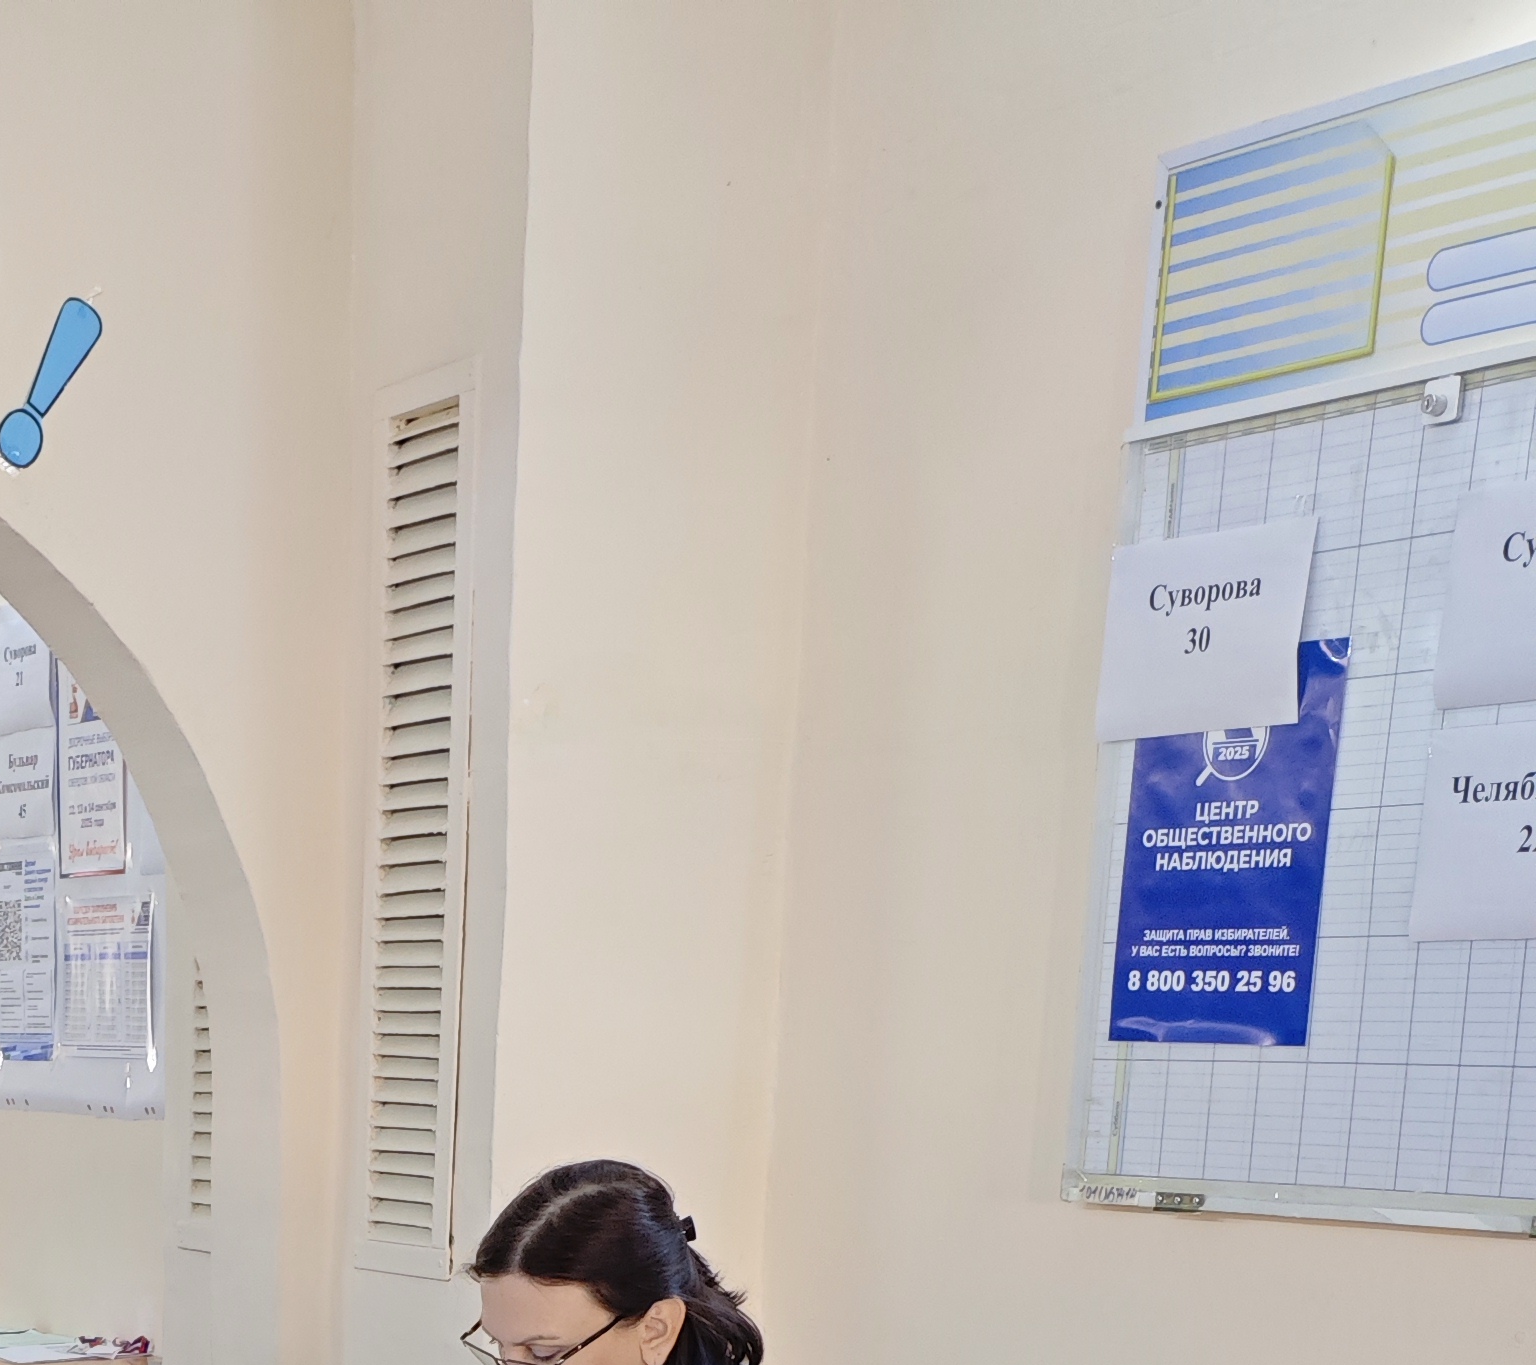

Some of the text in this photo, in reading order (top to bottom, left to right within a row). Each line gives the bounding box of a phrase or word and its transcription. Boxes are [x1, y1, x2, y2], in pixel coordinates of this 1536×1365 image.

[1149, 577, 1262, 617] Суворова
[1184, 625, 1211, 655] 30
[4, 643, 37, 665] Суворова
[8, 753, 39, 772] Бульвар
[1217, 745, 1250, 761] 2025
[1451, 771, 1536, 804] Челяб
[1195, 800, 1259, 824] ЦЕНТР
[1142, 822, 1312, 849] ОБЩЕСТВЕННОГО
[1516, 824, 1536, 854] 2
[1155, 848, 1293, 872] НАБЛЮДЕНИЯ
[1143, 926, 1290, 942] ЗАЩИТА ПРАВ ИЗБИРАТЕЛЕЙ.
[1131, 944, 1301, 957] У ВАС ЕСТЬ ВОПРОСЫ? ЗВОНИТЕ!
[1127, 970, 1296, 993] 8 800 350 25 96
